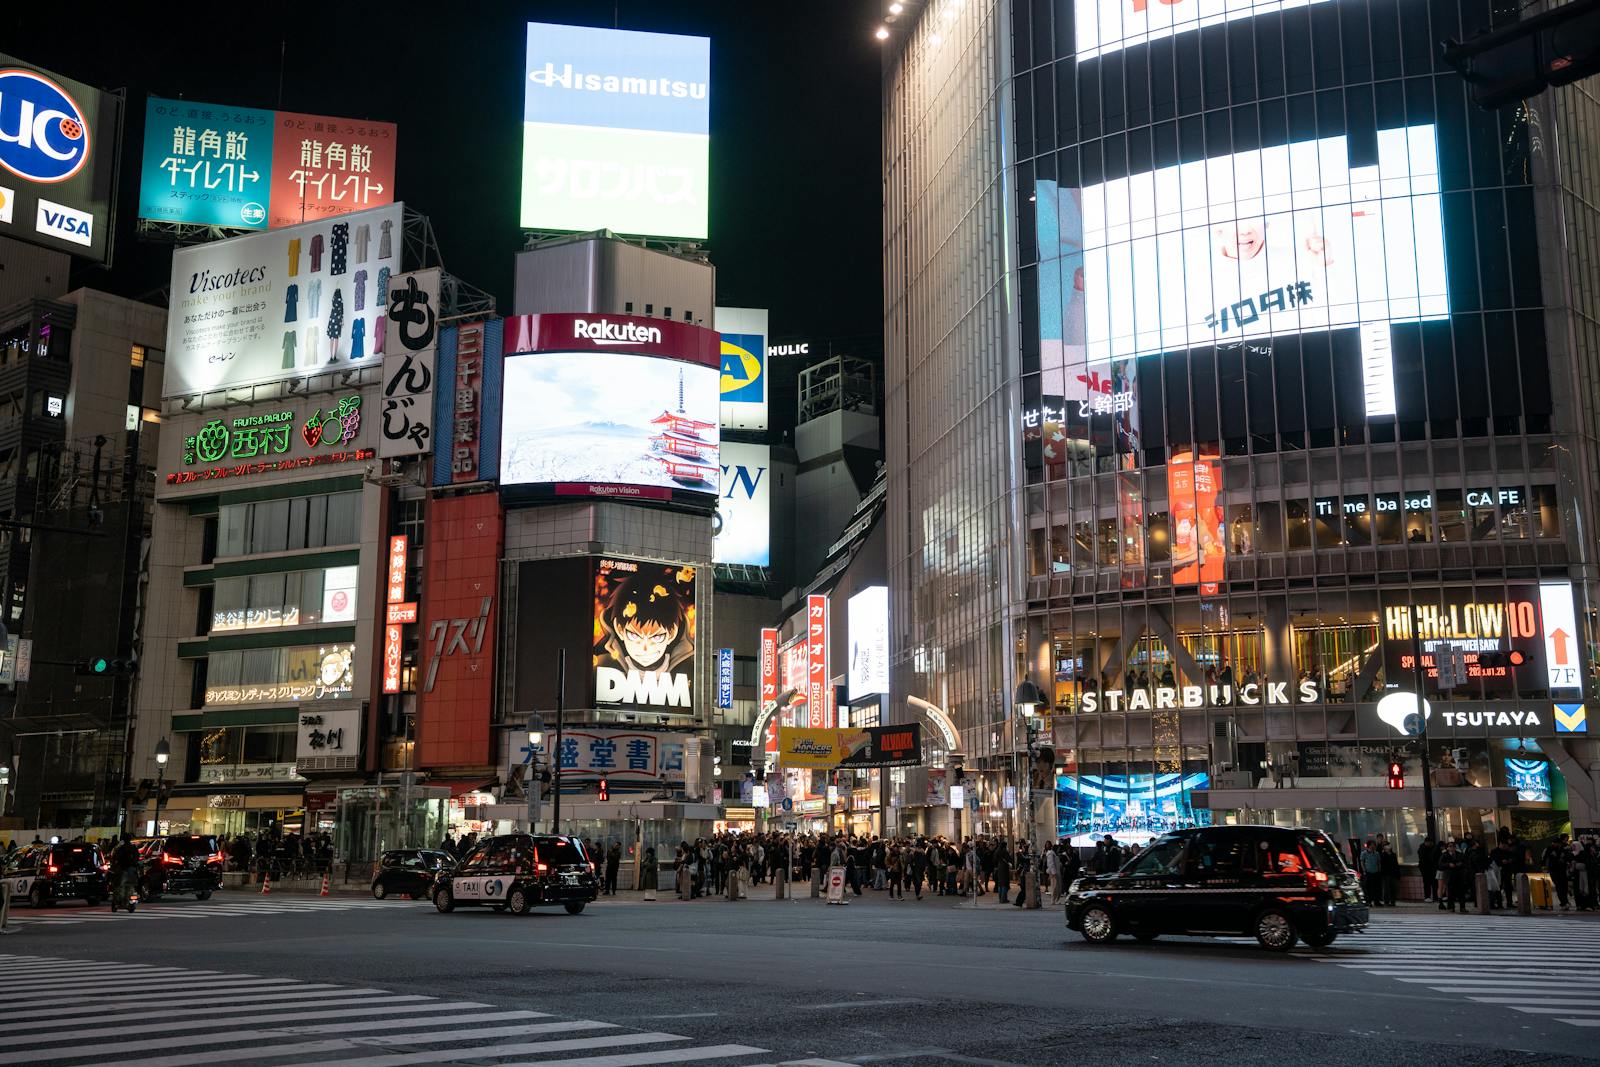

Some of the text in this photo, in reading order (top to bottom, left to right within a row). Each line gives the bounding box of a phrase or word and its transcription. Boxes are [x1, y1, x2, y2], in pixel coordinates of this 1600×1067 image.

[529, 62, 706, 100] Hisamitsu
[173, 126, 248, 160] 龍角散
[301, 139, 372, 173] 龍角散
[160, 157, 260, 192] ダイレクト
[288, 170, 384, 204] ダイレクト
[41, 208, 90, 238] VISA
[190, 265, 267, 294] Viscotecs
[240, 280, 272, 297] brand
[574, 318, 662, 345] Rakuten
[208, 351, 237, 364] セーレン
[382, 276, 435, 450] もんじゃ
[768, 343, 809, 357] HULIC
[454, 327, 480, 474] 三千里薬品
[233, 411, 295, 428] FRUITS&PARLOR
[183, 436, 196, 466] 渋谷
[231, 424, 292, 459] 西村
[589, 484, 640, 495] Rakuten Vision
[1466, 490, 1519, 508] CAFE
[1508, 601, 1536, 638] 10
[424, 596, 494, 693] クスリ
[810, 604, 824, 674] カラオケ
[1401, 655, 1435, 669] SPIAL
[1549, 668, 1576, 684] 7F
[596, 666, 692, 707] DMM
[1082, 681, 1319, 712] STARBUCKS
[1442, 710, 1541, 727] TSUTAYA
[463, 882, 479, 892] TAXI
[485, 879, 503, 896] GO
